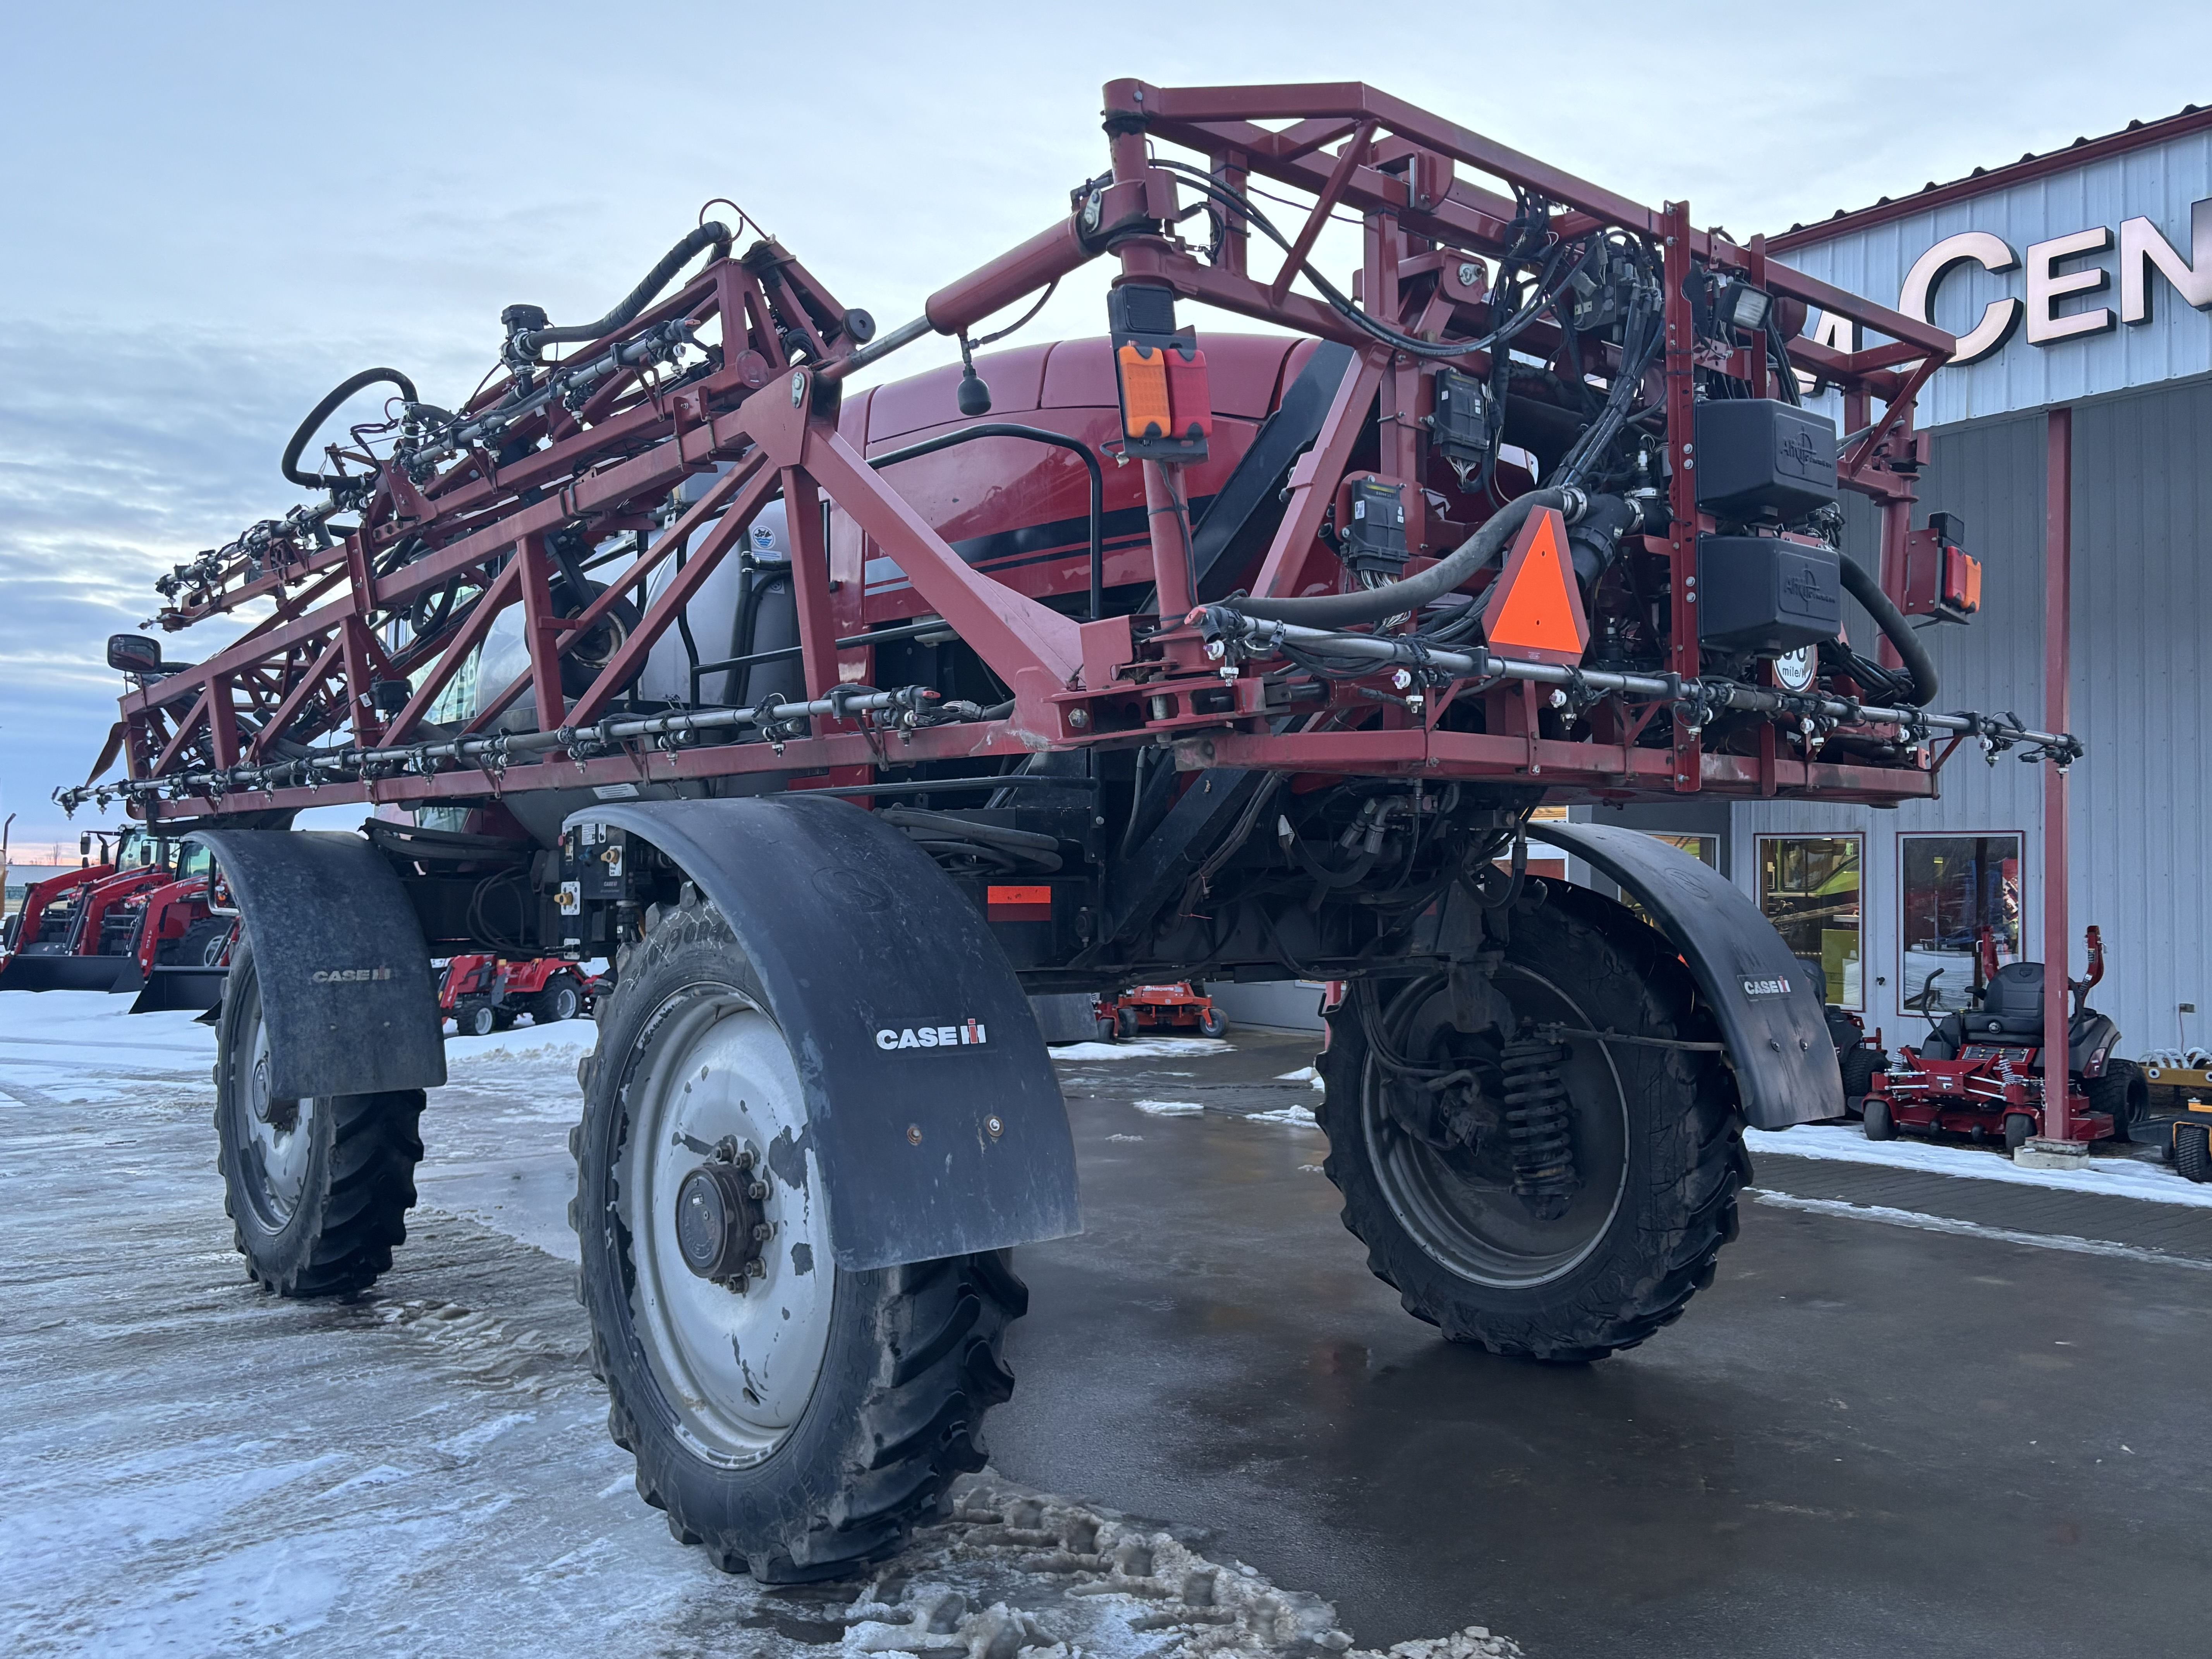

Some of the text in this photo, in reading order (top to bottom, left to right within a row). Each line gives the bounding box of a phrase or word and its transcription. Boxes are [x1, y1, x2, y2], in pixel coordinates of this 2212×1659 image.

[312, 969, 371, 983] CASE
[1744, 981, 1779, 994] CASE
[876, 1026, 958, 1050] CASE
